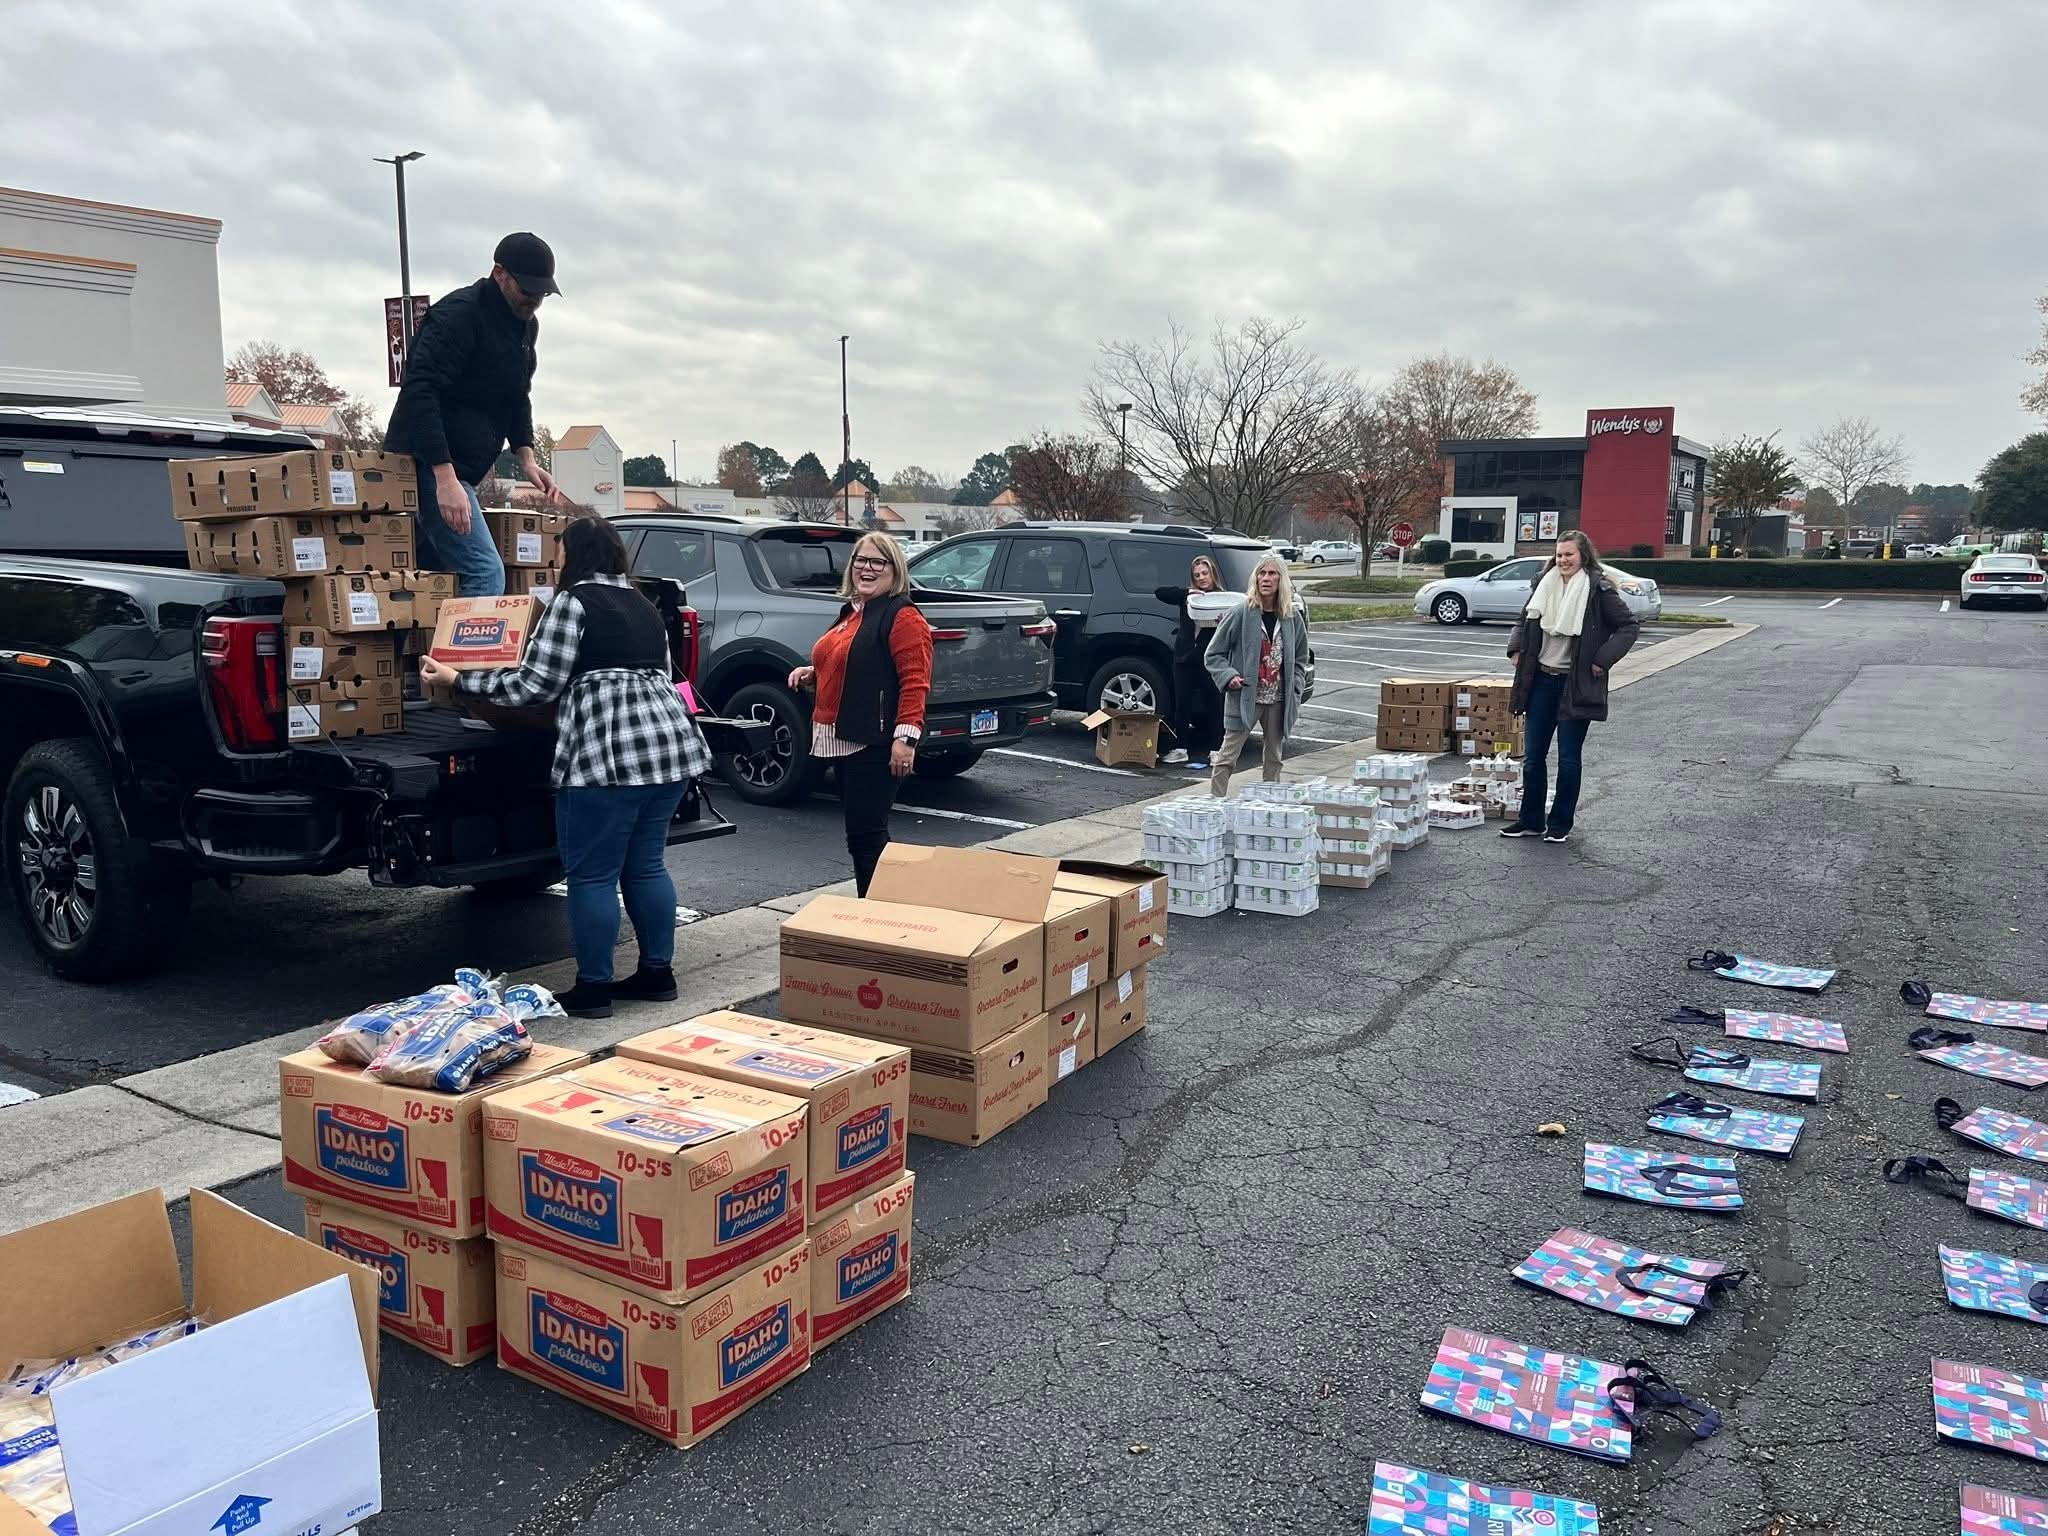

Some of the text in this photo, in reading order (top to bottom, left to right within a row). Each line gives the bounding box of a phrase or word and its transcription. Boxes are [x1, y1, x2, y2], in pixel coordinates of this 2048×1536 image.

[1591, 415, 1641, 436] Wendy's
[1393, 530, 1412, 541] STOP
[459, 626, 500, 636] IDAHO
[832, 912, 939, 934] KEEP REFRIGERATED
[886, 993, 961, 1019] Orchard Fresh
[976, 975, 1038, 1015] Orchard Fresh Apples
[871, 1059, 908, 1089] 10-5'S
[983, 1066, 1043, 1111] Orchard Fresh Apples
[404, 1101, 454, 1124] 10-5'S
[324, 1125, 397, 1162] IDAHO
[843, 1119, 886, 1152] IDAHO
[335, 1154, 390, 1177] potatoes
[567, 1159, 594, 1178] Farms
[616, 1150, 673, 1178] 10-5'S
[530, 1171, 608, 1217] IDAHO
[725, 1184, 782, 1223] IDAHO
[873, 1185, 913, 1217] 10-5'S
[542, 1202, 602, 1231] potatoes
[731, 1205, 776, 1237] potatoes
[403, 1229, 451, 1255] 10-5'S
[632, 1260, 661, 1278] IDAHO
[763, 1248, 809, 1289] 10-5'S
[845, 1248, 892, 1283] IDAHO
[850, 1267, 886, 1294] potatoes
[621, 1299, 678, 1332] 10-5'S
[539, 1311, 615, 1362] IDAHO
[727, 1321, 785, 1364] IDAHO
[546, 1345, 607, 1376] potatoes
[735, 1341, 778, 1379] potatoes
[637, 1405, 666, 1427] IDAHO
